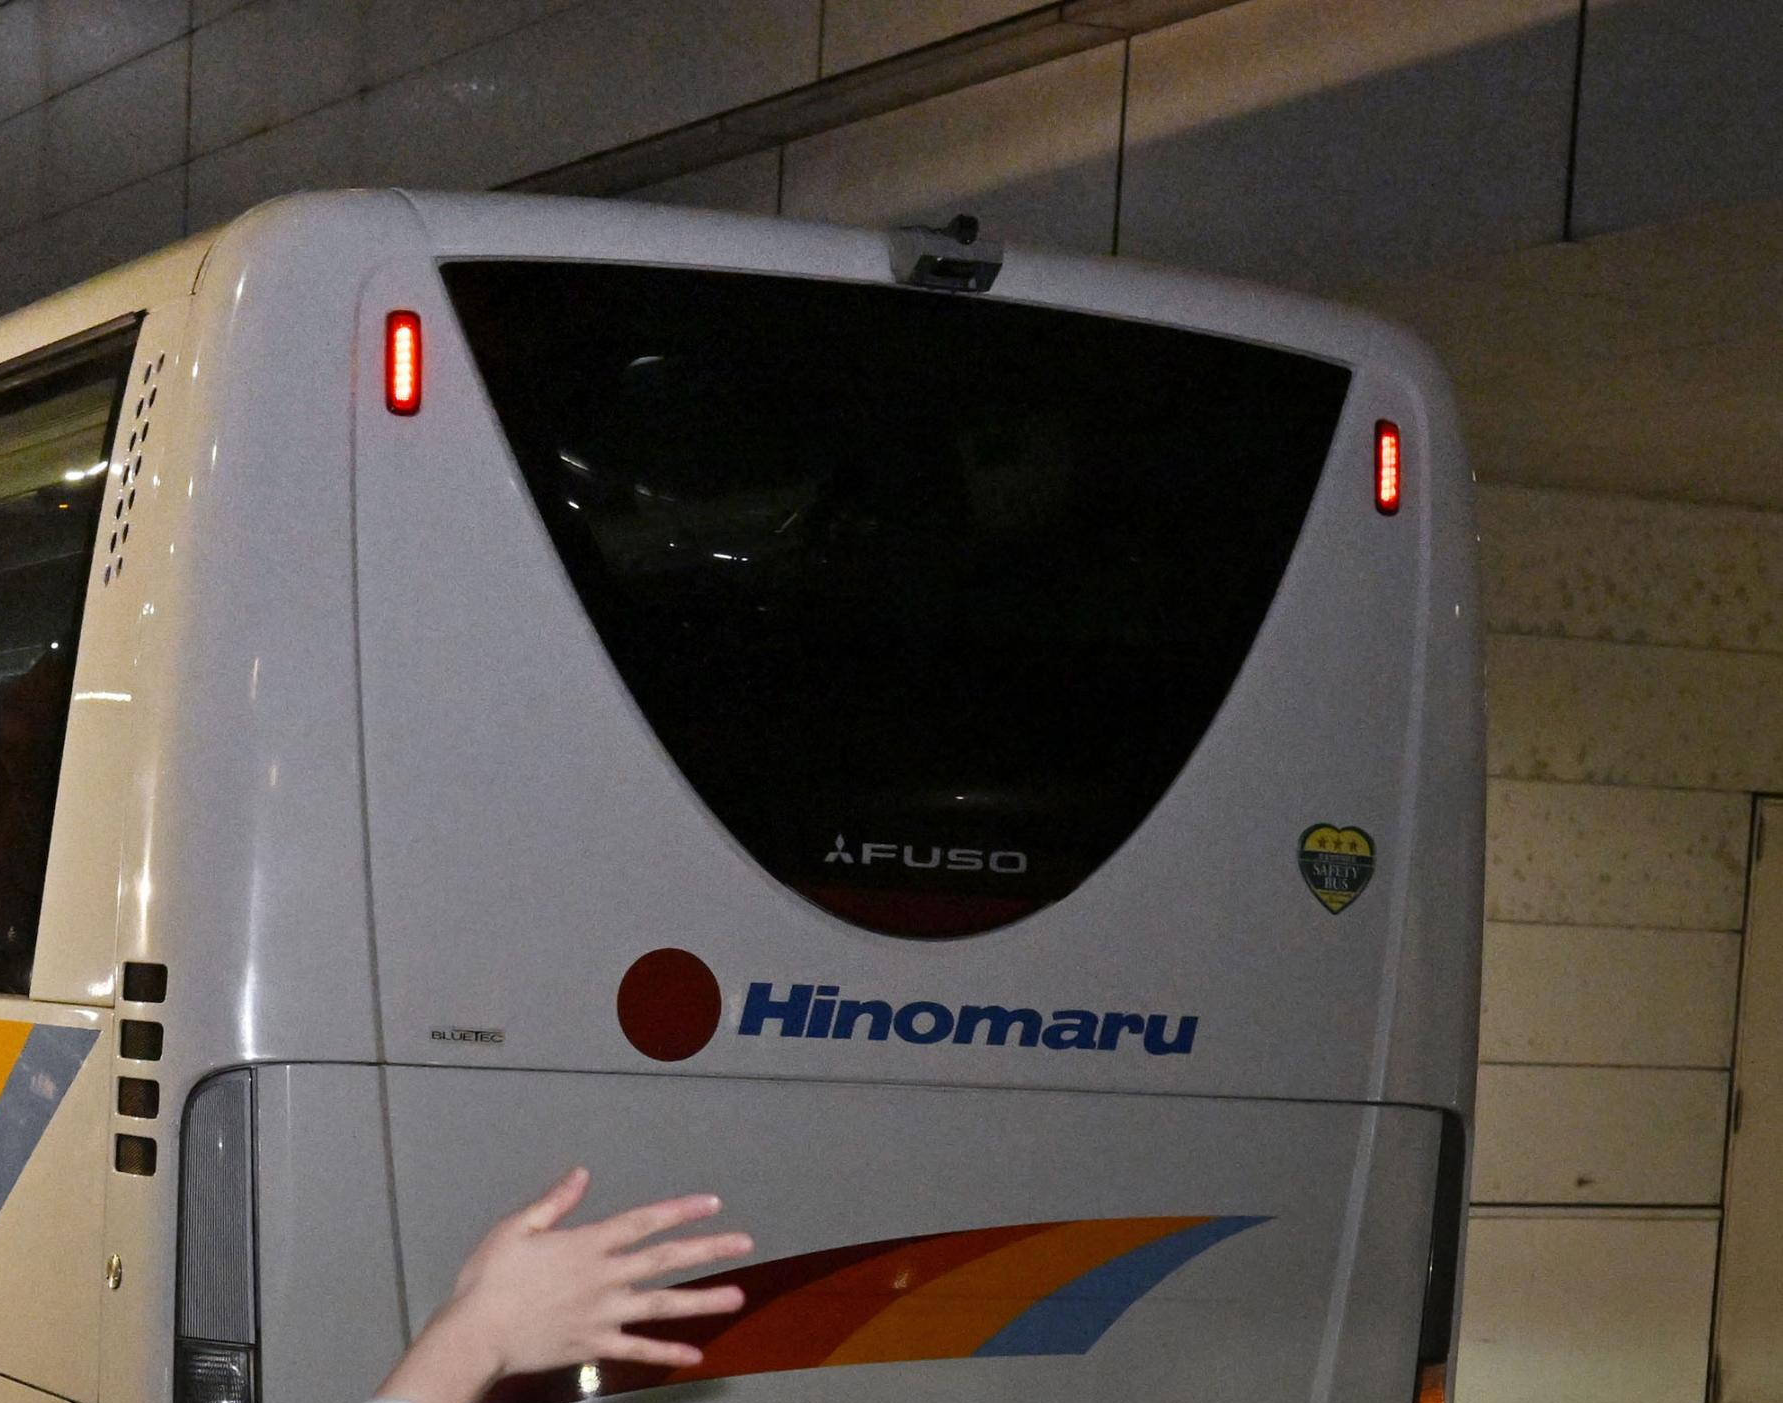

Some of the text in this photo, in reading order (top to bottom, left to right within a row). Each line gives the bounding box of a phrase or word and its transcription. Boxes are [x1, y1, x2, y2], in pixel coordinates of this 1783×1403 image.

[862, 843, 1027, 873] FUSO
[1313, 863, 1358, 879] SAFETY
[1324, 877, 1349, 890] BUS
[738, 982, 1198, 1056] Hinomaru
